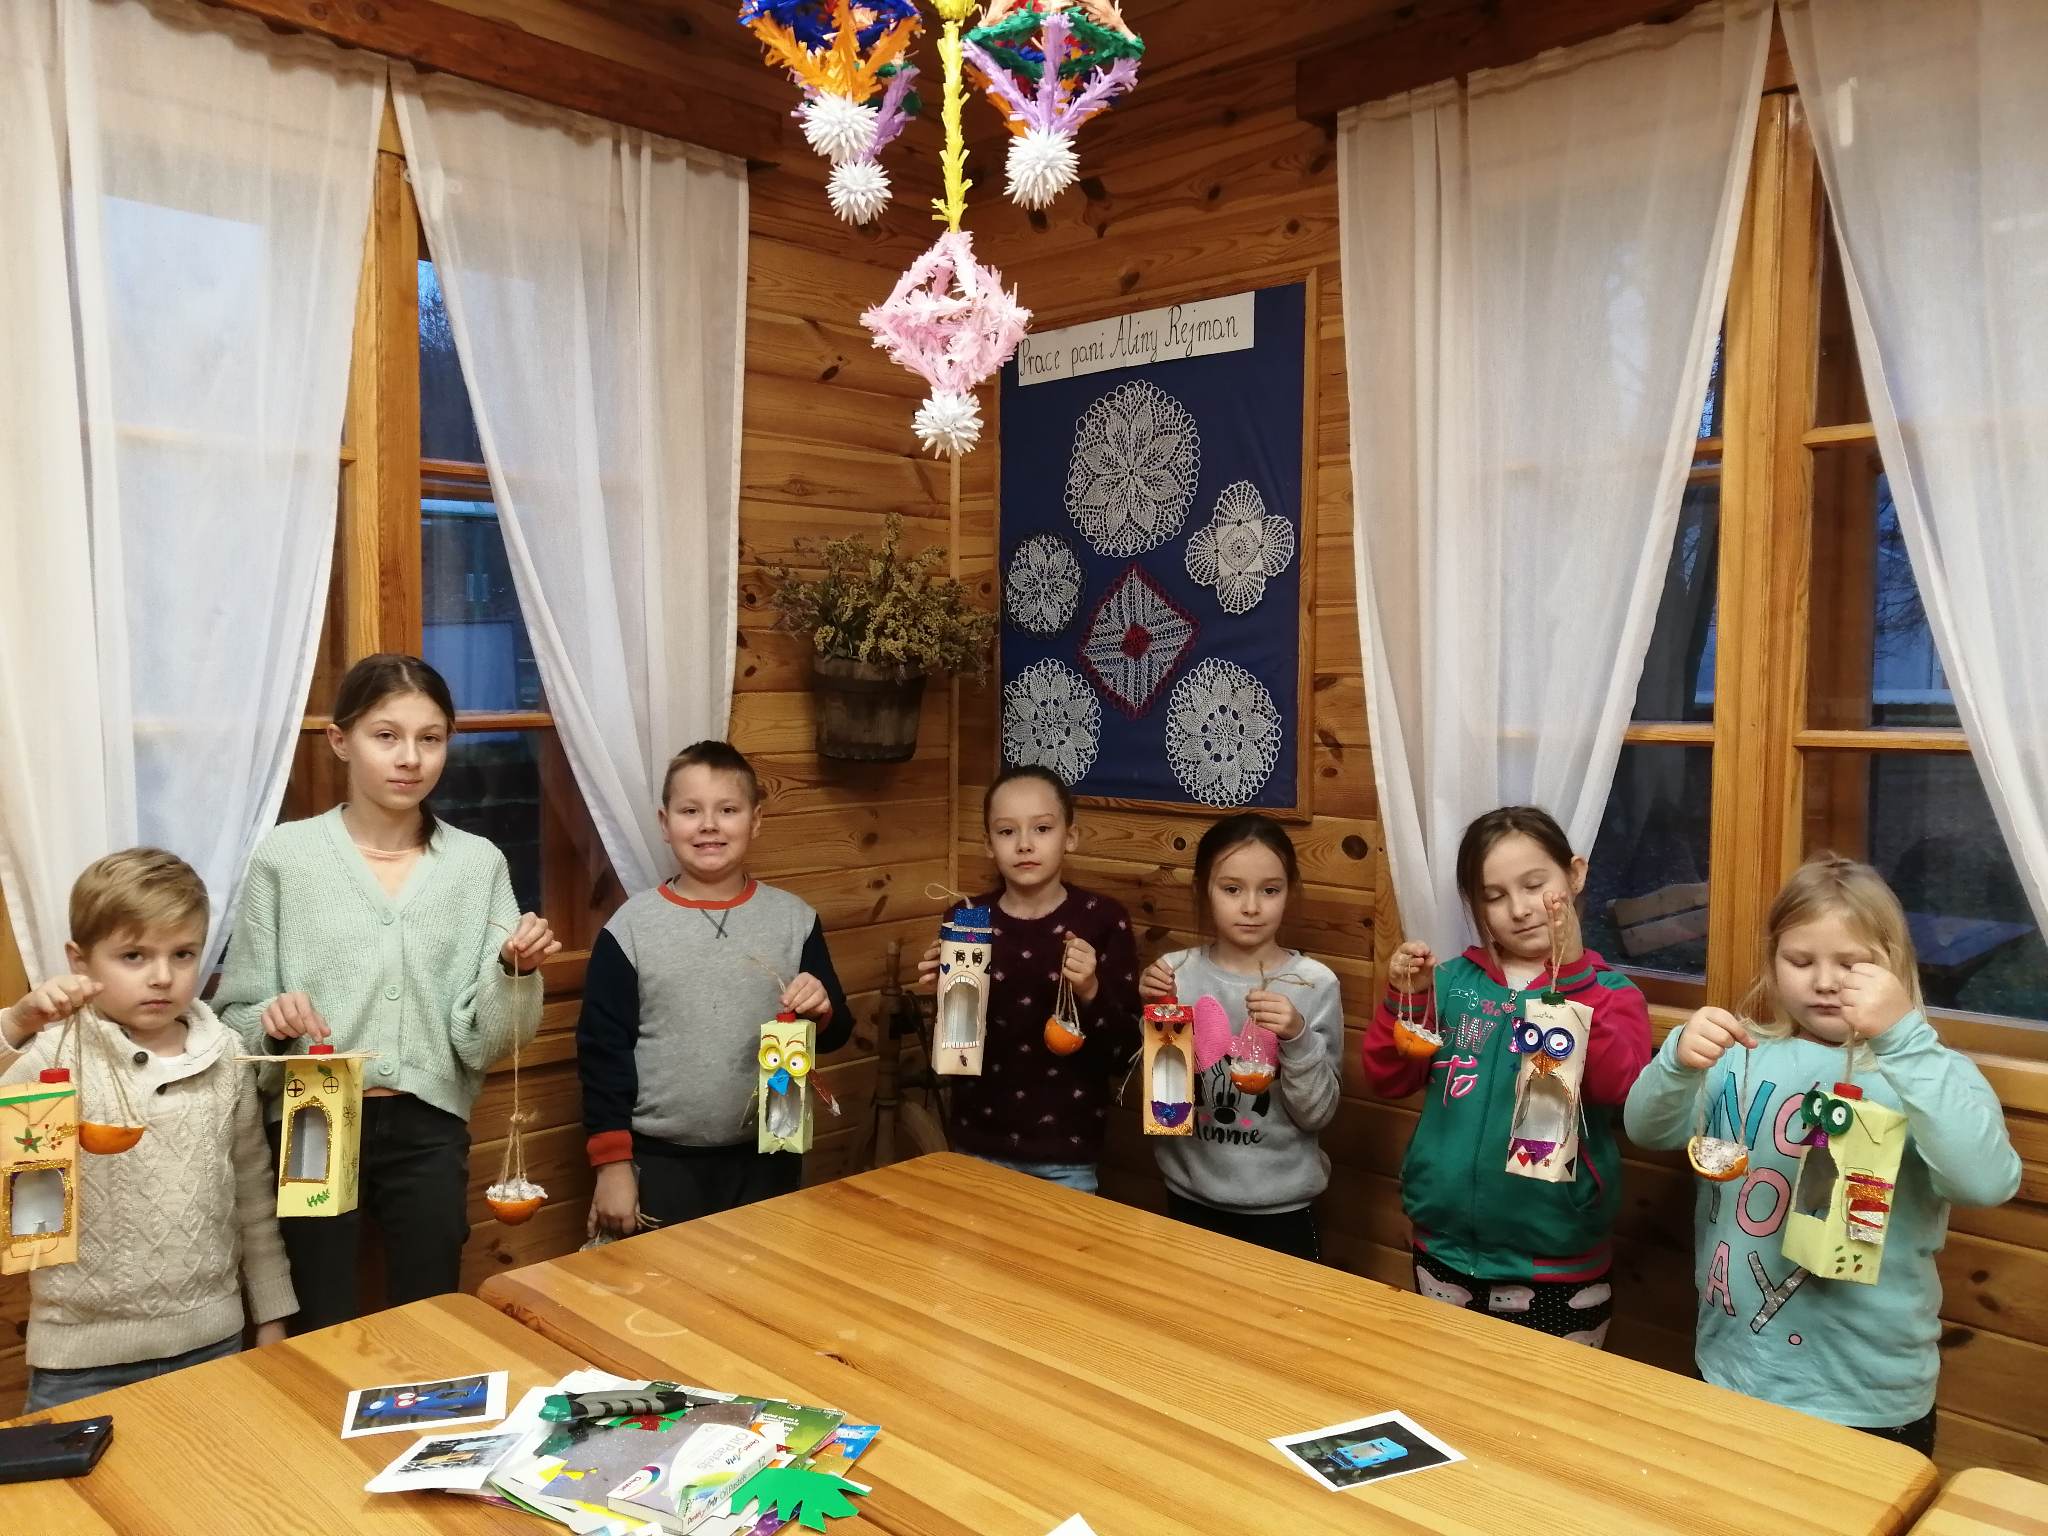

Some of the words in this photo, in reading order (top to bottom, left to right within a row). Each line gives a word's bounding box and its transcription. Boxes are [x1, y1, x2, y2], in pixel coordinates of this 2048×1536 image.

[1019, 336, 1060, 377] Prace
[1071, 332, 1105, 376] pani
[1109, 313, 1159, 363] Aliny
[1164, 304, 1239, 357] Rejman
